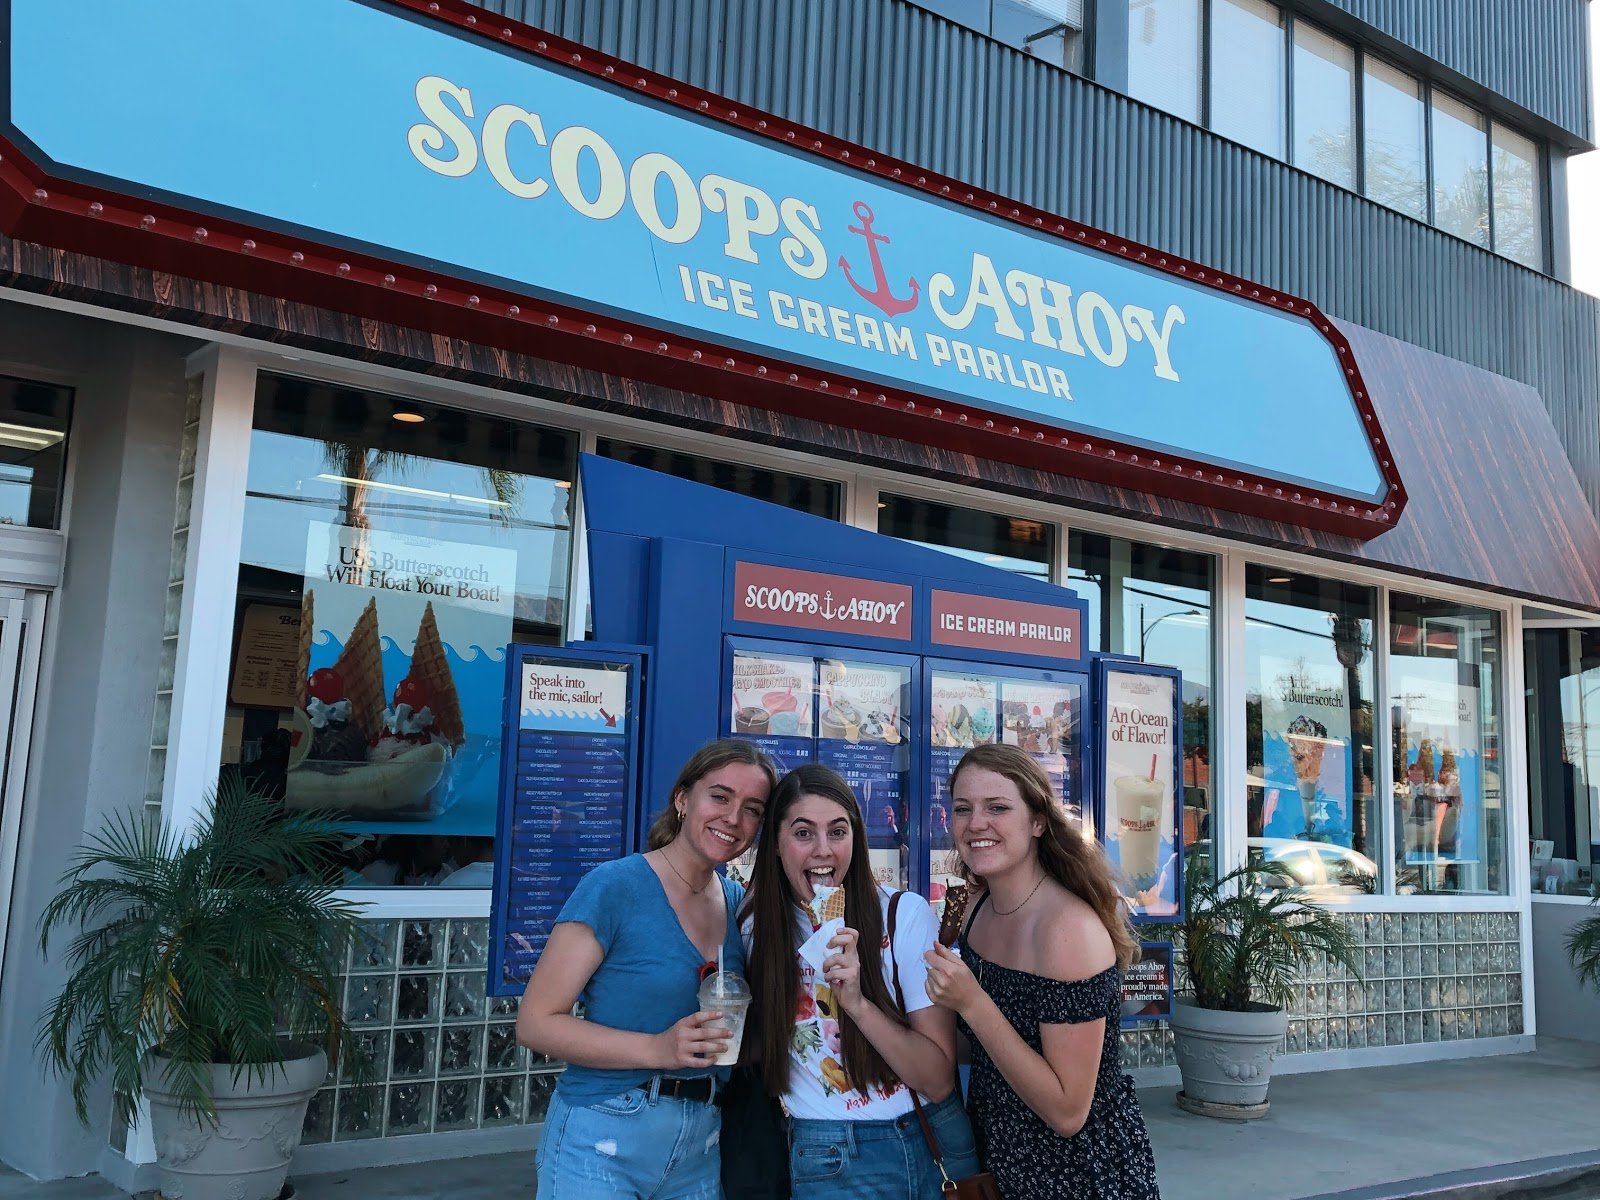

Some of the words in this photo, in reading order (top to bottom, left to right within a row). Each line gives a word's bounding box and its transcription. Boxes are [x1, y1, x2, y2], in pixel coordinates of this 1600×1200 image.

[406, 74, 827, 281] SCOOPS
[929, 252, 1186, 383] AHOY
[678, 264, 760, 320] ICE
[767, 290, 919, 362] CREAM
[929, 334, 1075, 402] PARLOR
[382, 552, 489, 583] Butterscotch
[326, 564, 363, 586] Will
[368, 569, 412, 592] Float
[415, 575, 453, 597] Your
[456, 581, 500, 602] Boat!
[745, 585, 818, 615] SCOOPS
[837, 598, 905, 625] AHOY
[941, 613, 964, 631] ICE
[968, 616, 1016, 637] CREAM
[1019, 621, 1072, 643] PARLOR
[529, 672, 562, 690] Speak
[565, 675, 586, 689] into
[529, 686, 546, 701] the
[548, 689, 571, 704] mic,
[571, 691, 603, 704] sailor!
[1110, 706, 1128, 724] An
[1130, 708, 1169, 728] Ocean
[1111, 724, 1126, 742] of
[1128, 725, 1167, 745] Flavor!
[1127, 963, 1147, 972] coops
[1148, 961, 1166, 972] Ahoy
[1158, 972, 1165, 981] is
[1121, 981, 1148, 993] proudly
[1148, 981, 1169, 991] made
[1124, 992, 1132, 1001] in
[1133, 992, 1165, 1001] America.
